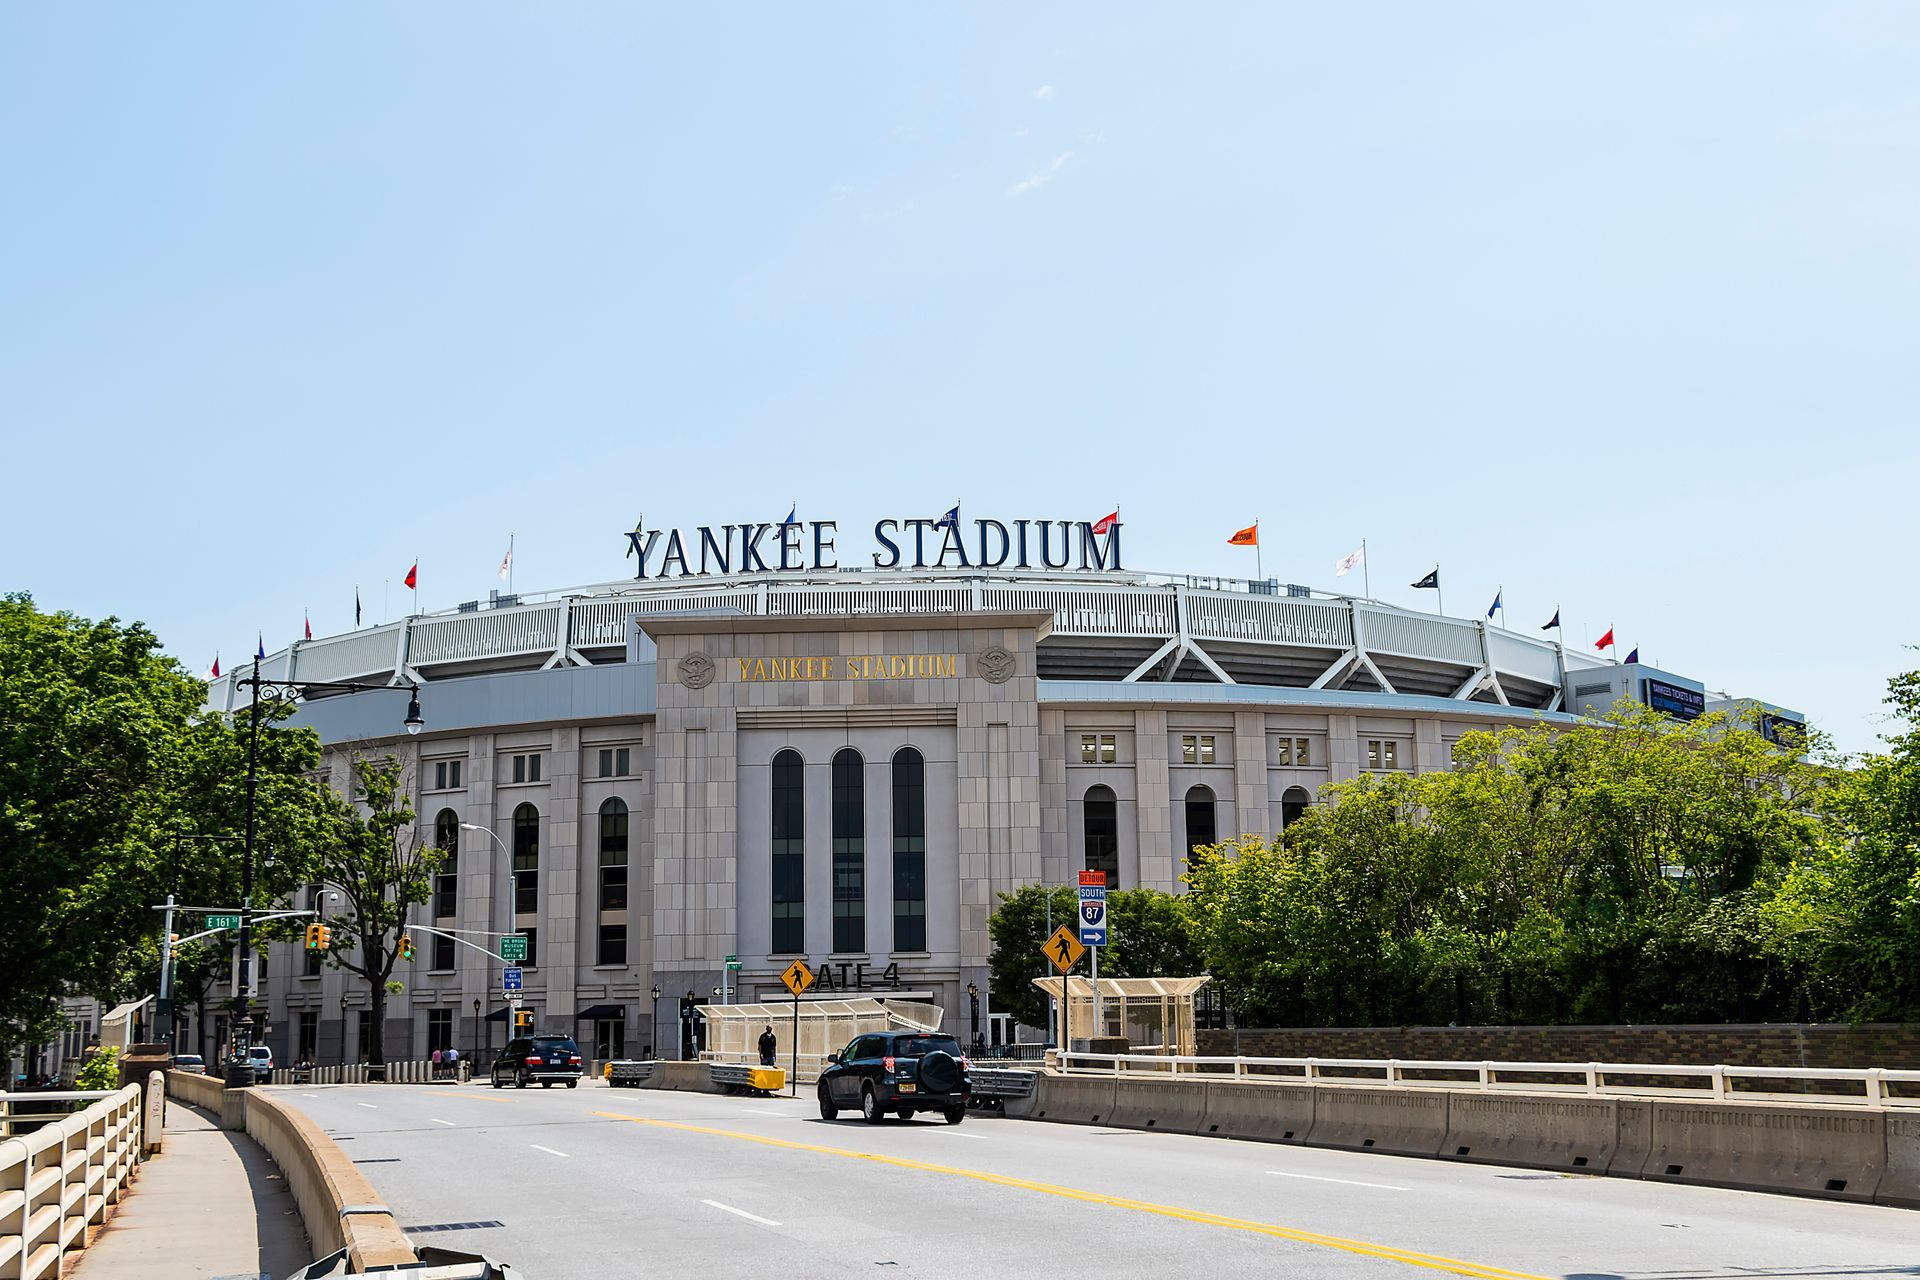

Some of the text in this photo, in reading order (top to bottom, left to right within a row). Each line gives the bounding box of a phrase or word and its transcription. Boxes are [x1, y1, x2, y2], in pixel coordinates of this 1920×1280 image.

[624, 519, 1125, 580] YANKEE STADIUM
[738, 655, 956, 681] YANKEE STADIUM
[1080, 874, 1104, 883] DETOUR
[1081, 888, 1104, 898] SOUTH
[1086, 907, 1099, 919] 87
[208, 917, 213, 927] E
[216, 917, 230, 927] 161
[805, 963, 900, 989] ATE 4
